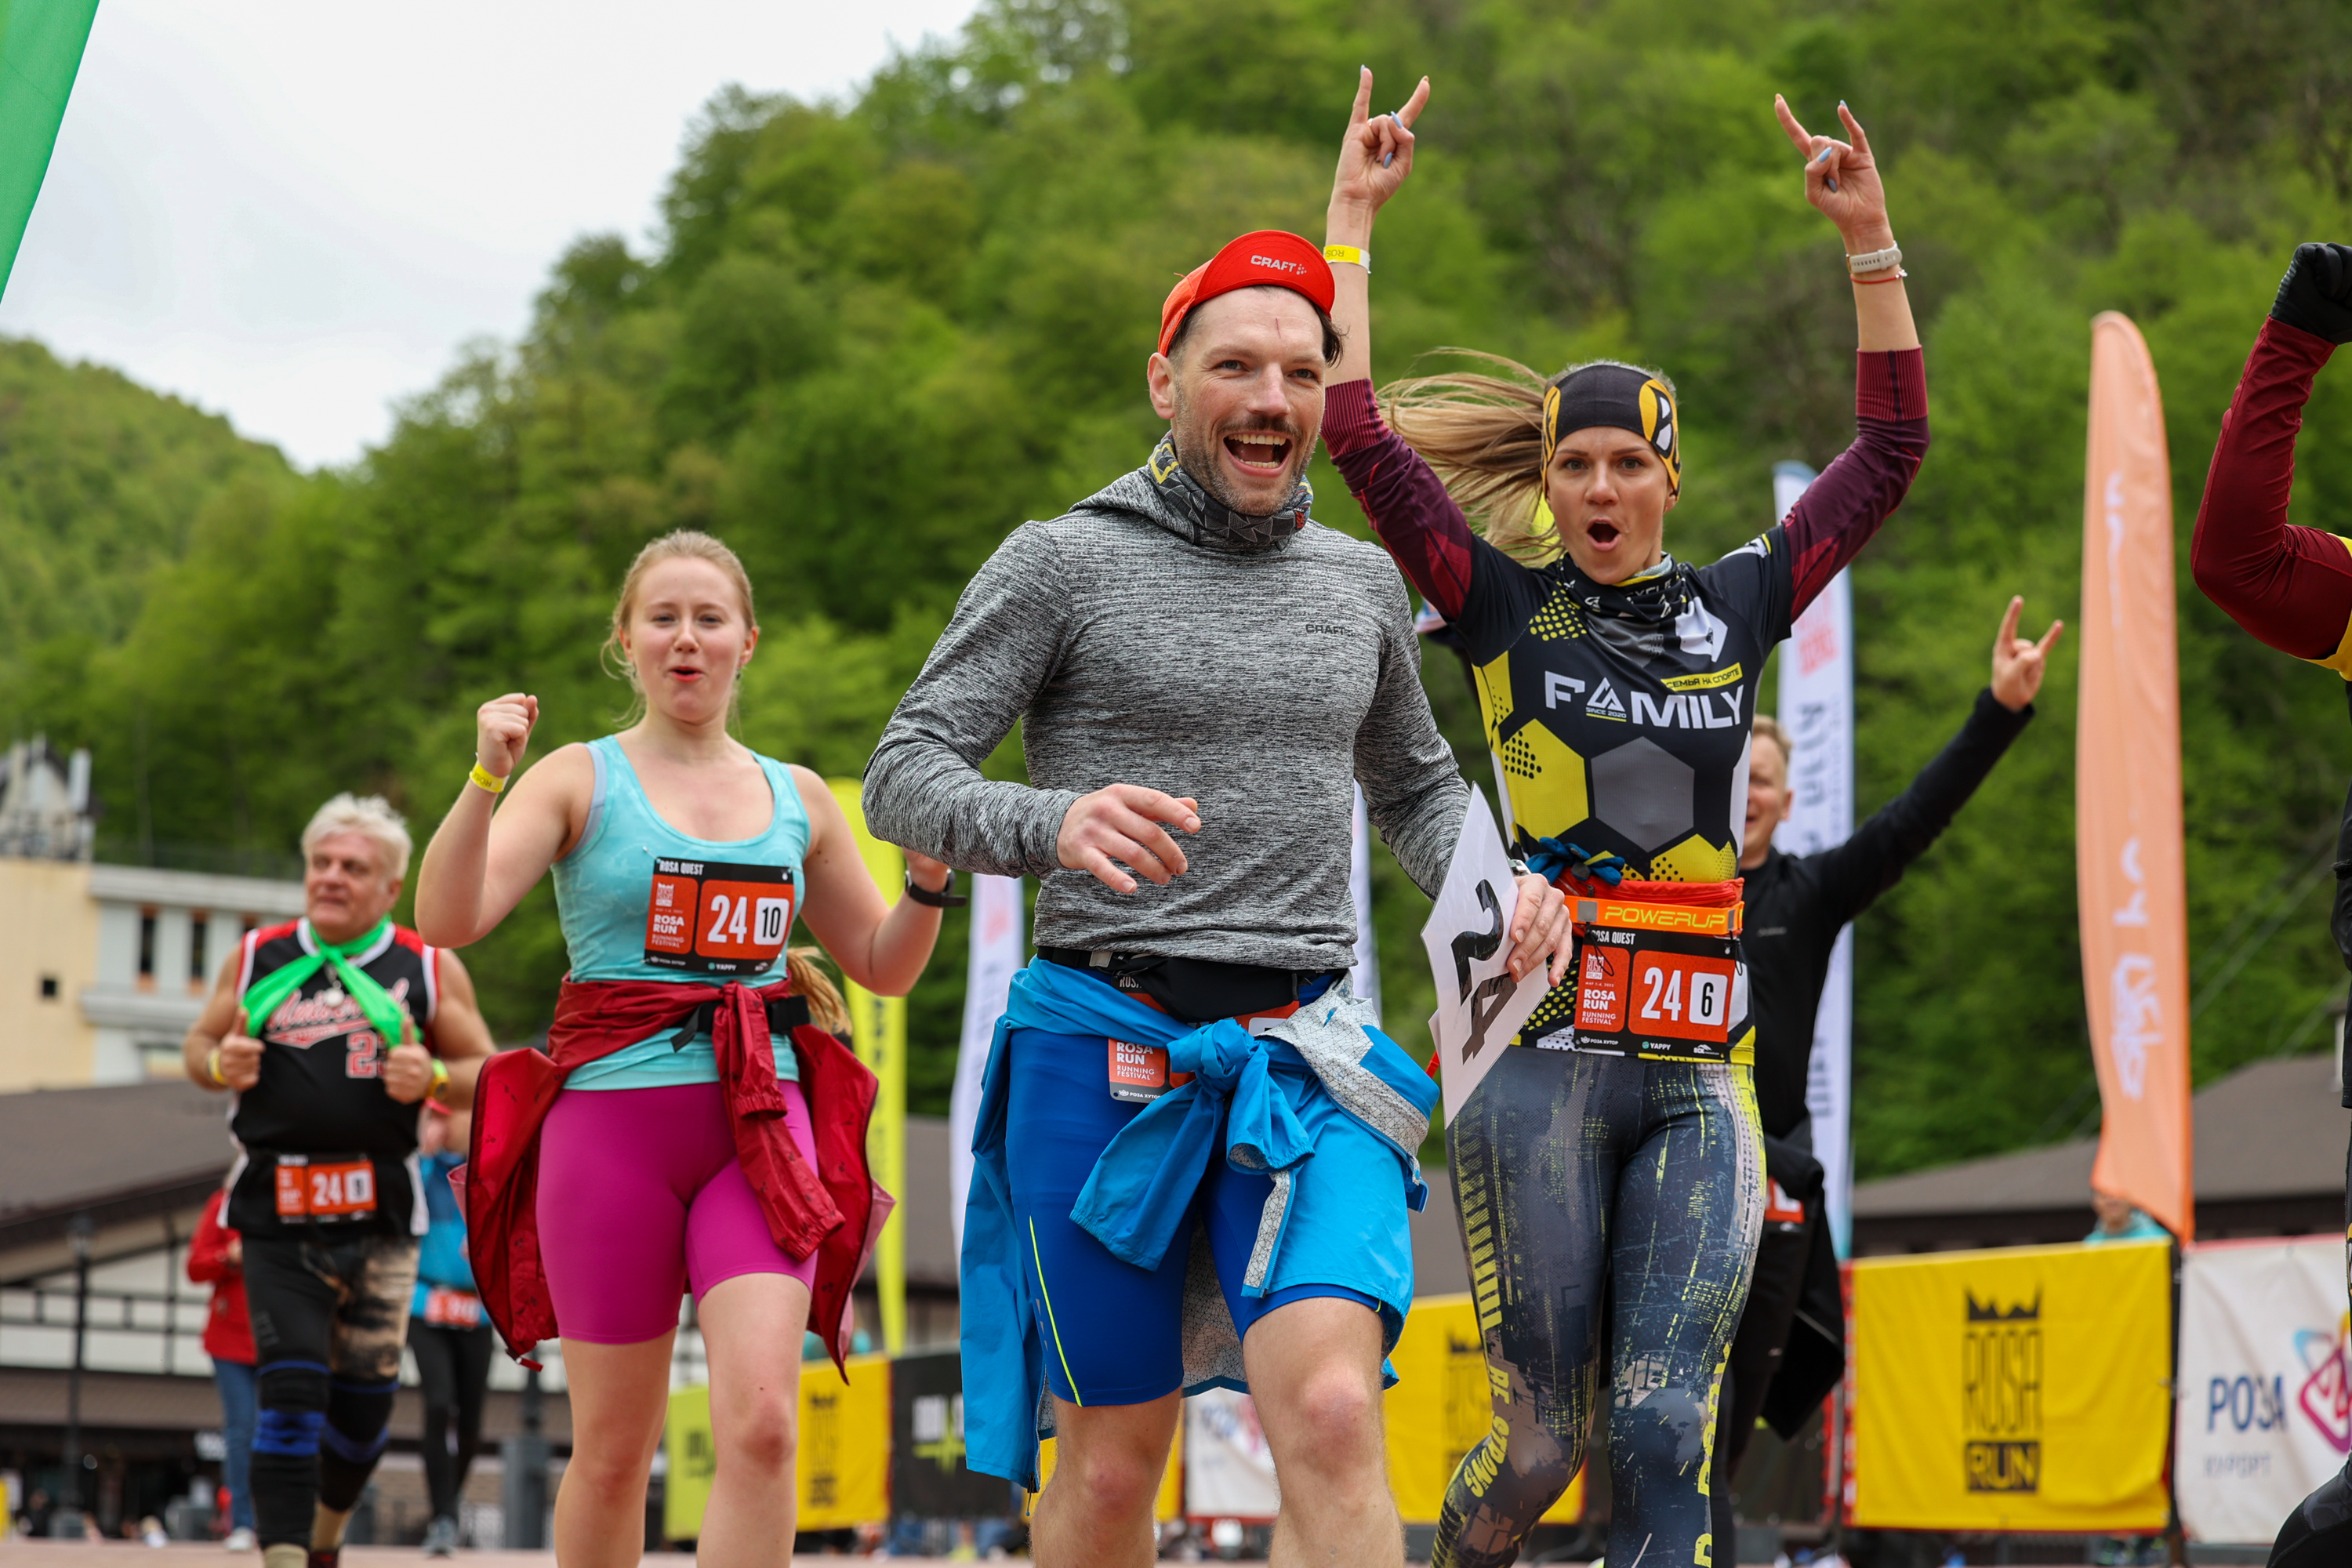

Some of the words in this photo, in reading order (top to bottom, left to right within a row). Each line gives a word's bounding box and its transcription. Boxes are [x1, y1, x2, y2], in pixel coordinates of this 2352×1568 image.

[1325, 249, 1345, 258] ROS
[1250, 255, 1296, 273] CRAFT
[1305, 624, 1345, 635] CRAFT
[1666, 678, 1700, 688] СЕМЬЯ
[1712, 667, 1740, 684] СПОРТЕ
[1544, 670, 1744, 729] FAMILY
[1585, 706, 1606, 716] SINCE
[1607, 710, 1627, 719] 2020
[659, 861, 680, 874] ROSA
[681, 863, 704, 876] QUEST
[654, 914, 685, 927] ROSA
[707, 894, 748, 945] 24
[762, 906, 781, 938] 10
[1605, 906, 1725, 929] POWERUP
[652, 924, 678, 935] RUN
[652, 934, 684, 943] RUNNING
[652, 939, 680, 948] FESTIVAL
[1612, 931, 1635, 945] QUEST
[715, 963, 737, 971] YAPPY
[1450, 879, 1519, 1066] 24
[1584, 989, 1616, 1001] ROSA
[1641, 967, 1682, 1021] 24
[1700, 982, 1714, 1017] 6
[1583, 999, 1609, 1011] RUN
[1581, 1017, 1612, 1025] FESTIVAL
[1582, 1011, 1616, 1019] RUNNING
[1116, 1042, 1153, 1054] ROSA
[1116, 1052, 1145, 1065] RUN
[1116, 1065, 1155, 1075] RUNNING
[1116, 1070, 1151, 1080] FESTIVAL
[312, 1171, 343, 1207] 24
[1489, 1366, 1510, 1404] BE
[1965, 1329, 2043, 1432] ROSA
[2207, 1376, 2287, 1433] РОЗА
[1967, 1444, 2038, 1490] RUN
